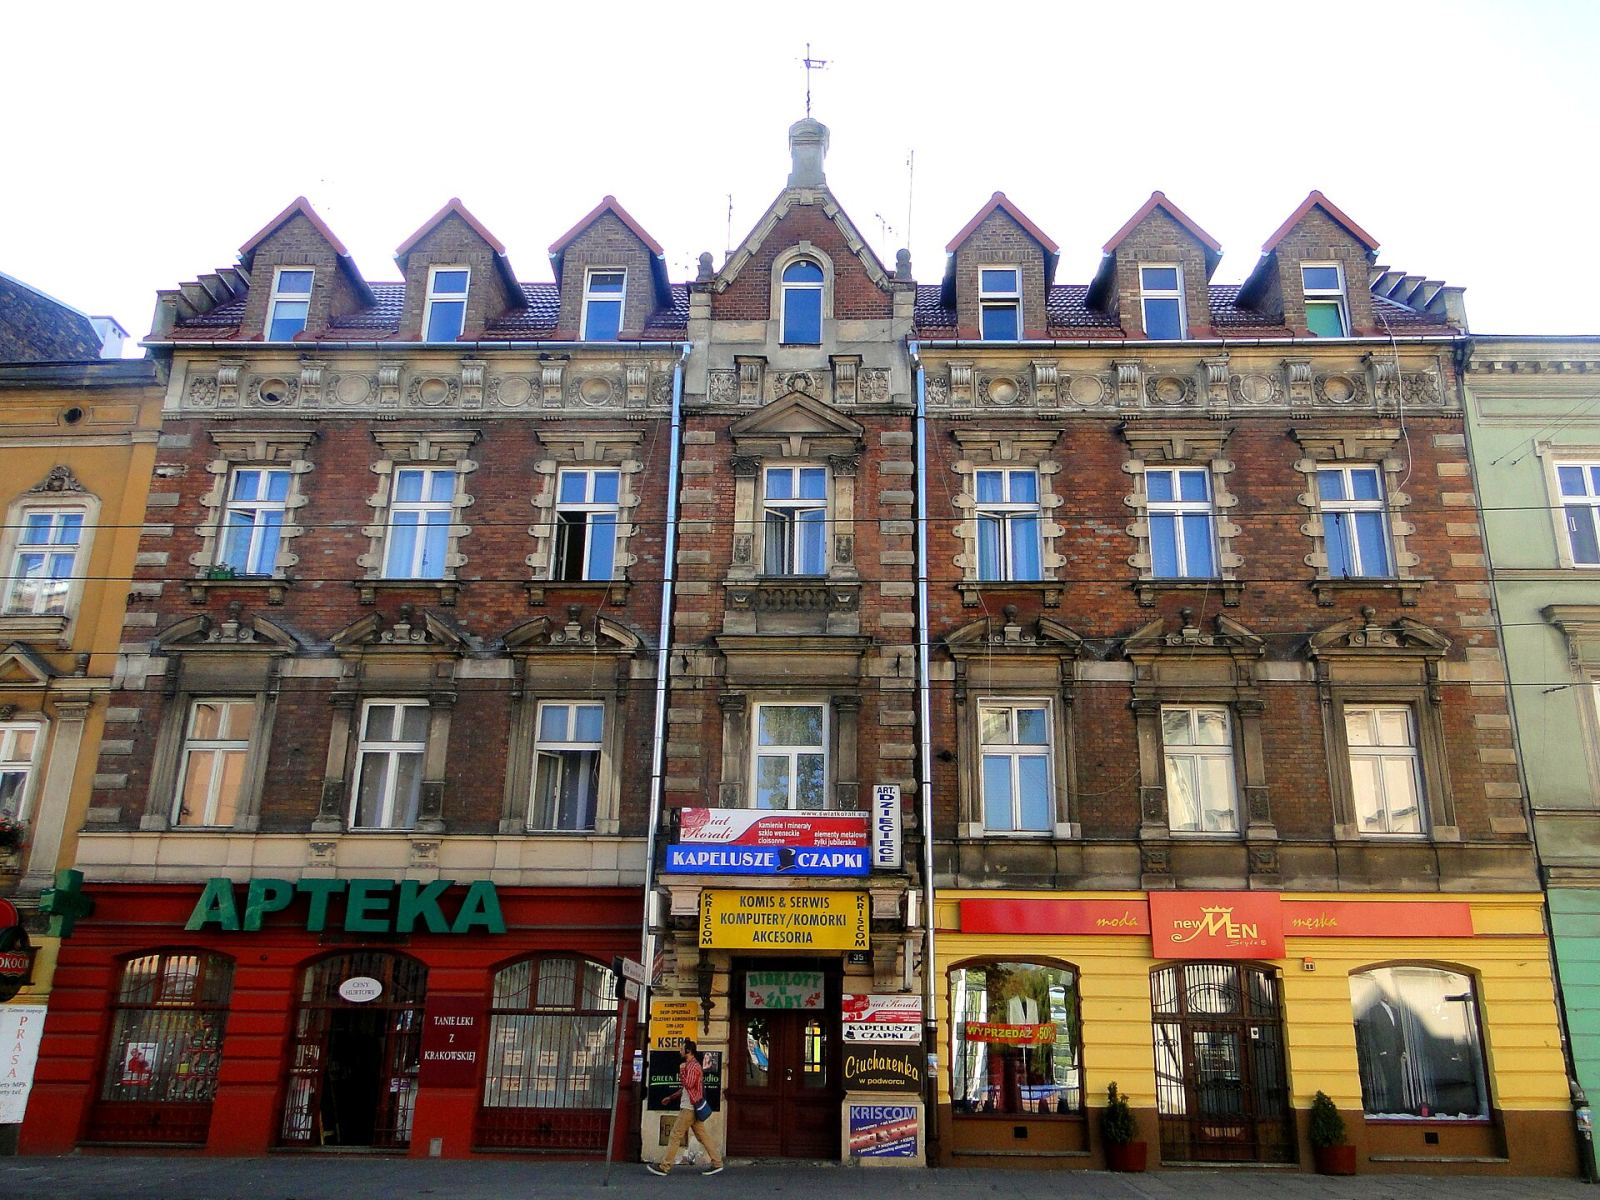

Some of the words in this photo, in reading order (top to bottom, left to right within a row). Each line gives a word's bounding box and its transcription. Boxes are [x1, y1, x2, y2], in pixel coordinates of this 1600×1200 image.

[877, 786, 895, 794] ART.
[758, 821, 784, 829] kamienie
[814, 831, 840, 839] elementy
[828, 838, 857, 847] jubilerskie
[673, 851, 774, 867] KAPELUSZE
[798, 853, 862, 868] CZAPKI
[184, 877, 507, 934] APTEKA
[739, 895, 775, 908] KOMIS
[778, 896, 786, 908] &
[790, 896, 830, 909] SERWIS
[701, 893, 713, 945] KRISCOM
[854, 895, 866, 947] KRISCOM
[1096, 911, 1138, 927] moda
[1292, 912, 1338, 930] męska
[752, 930, 813, 944] AKCESORIA
[853, 953, 864, 961] 35
[434, 1016, 456, 1026] TANIE
[456, 1016, 474, 1026] LEKI
[848, 1024, 916, 1032] KAPELUSZE
[966, 1026, 1033, 1039] WYPRZEDAŻ
[7, 1016, 28, 1078] PRASA
[424, 1051, 476, 1063] KRAKOWSKIEJ
[851, 1106, 917, 1120] KRISCOM
